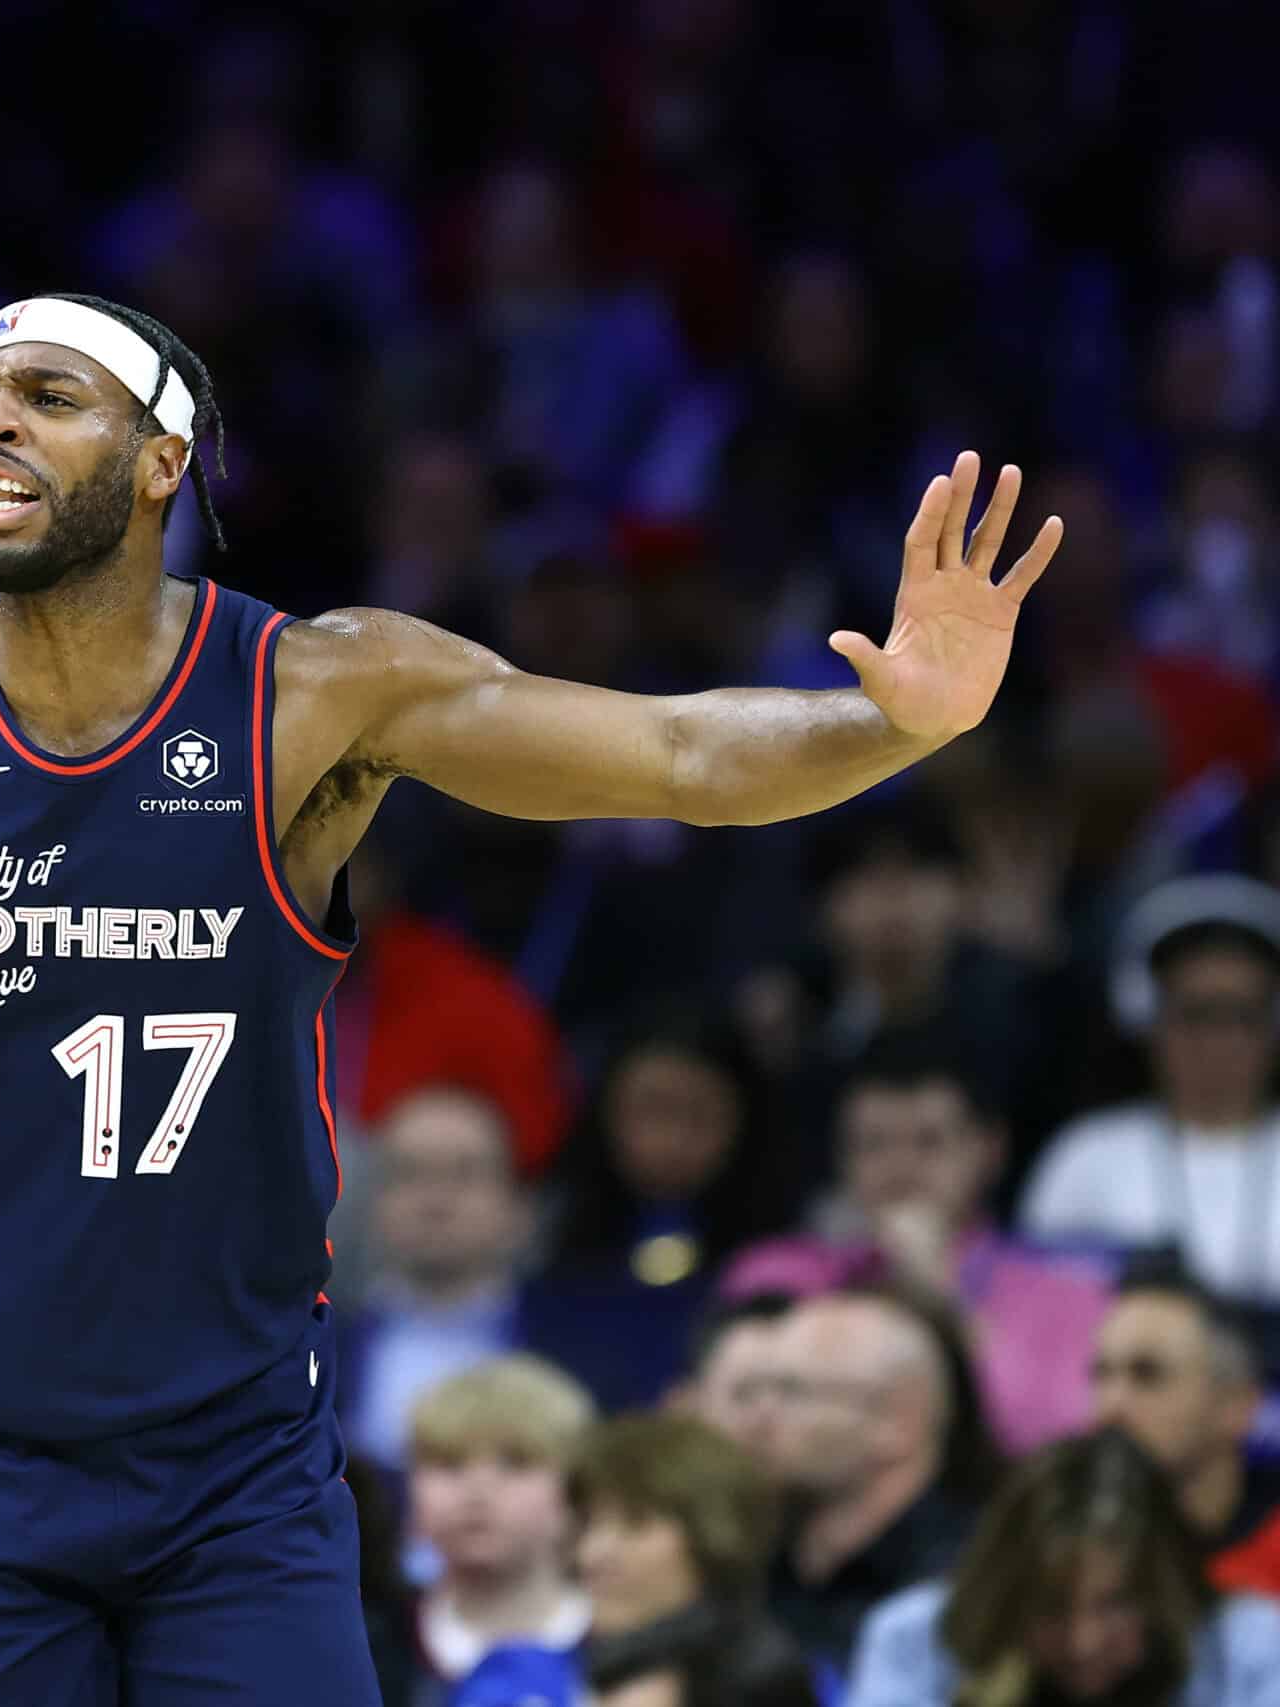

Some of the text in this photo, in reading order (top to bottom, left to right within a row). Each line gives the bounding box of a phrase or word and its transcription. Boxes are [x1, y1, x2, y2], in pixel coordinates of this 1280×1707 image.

[139, 797, 243, 814] crypto.com
[26, 844, 67, 886] of
[50, 1012, 238, 1179] 17
